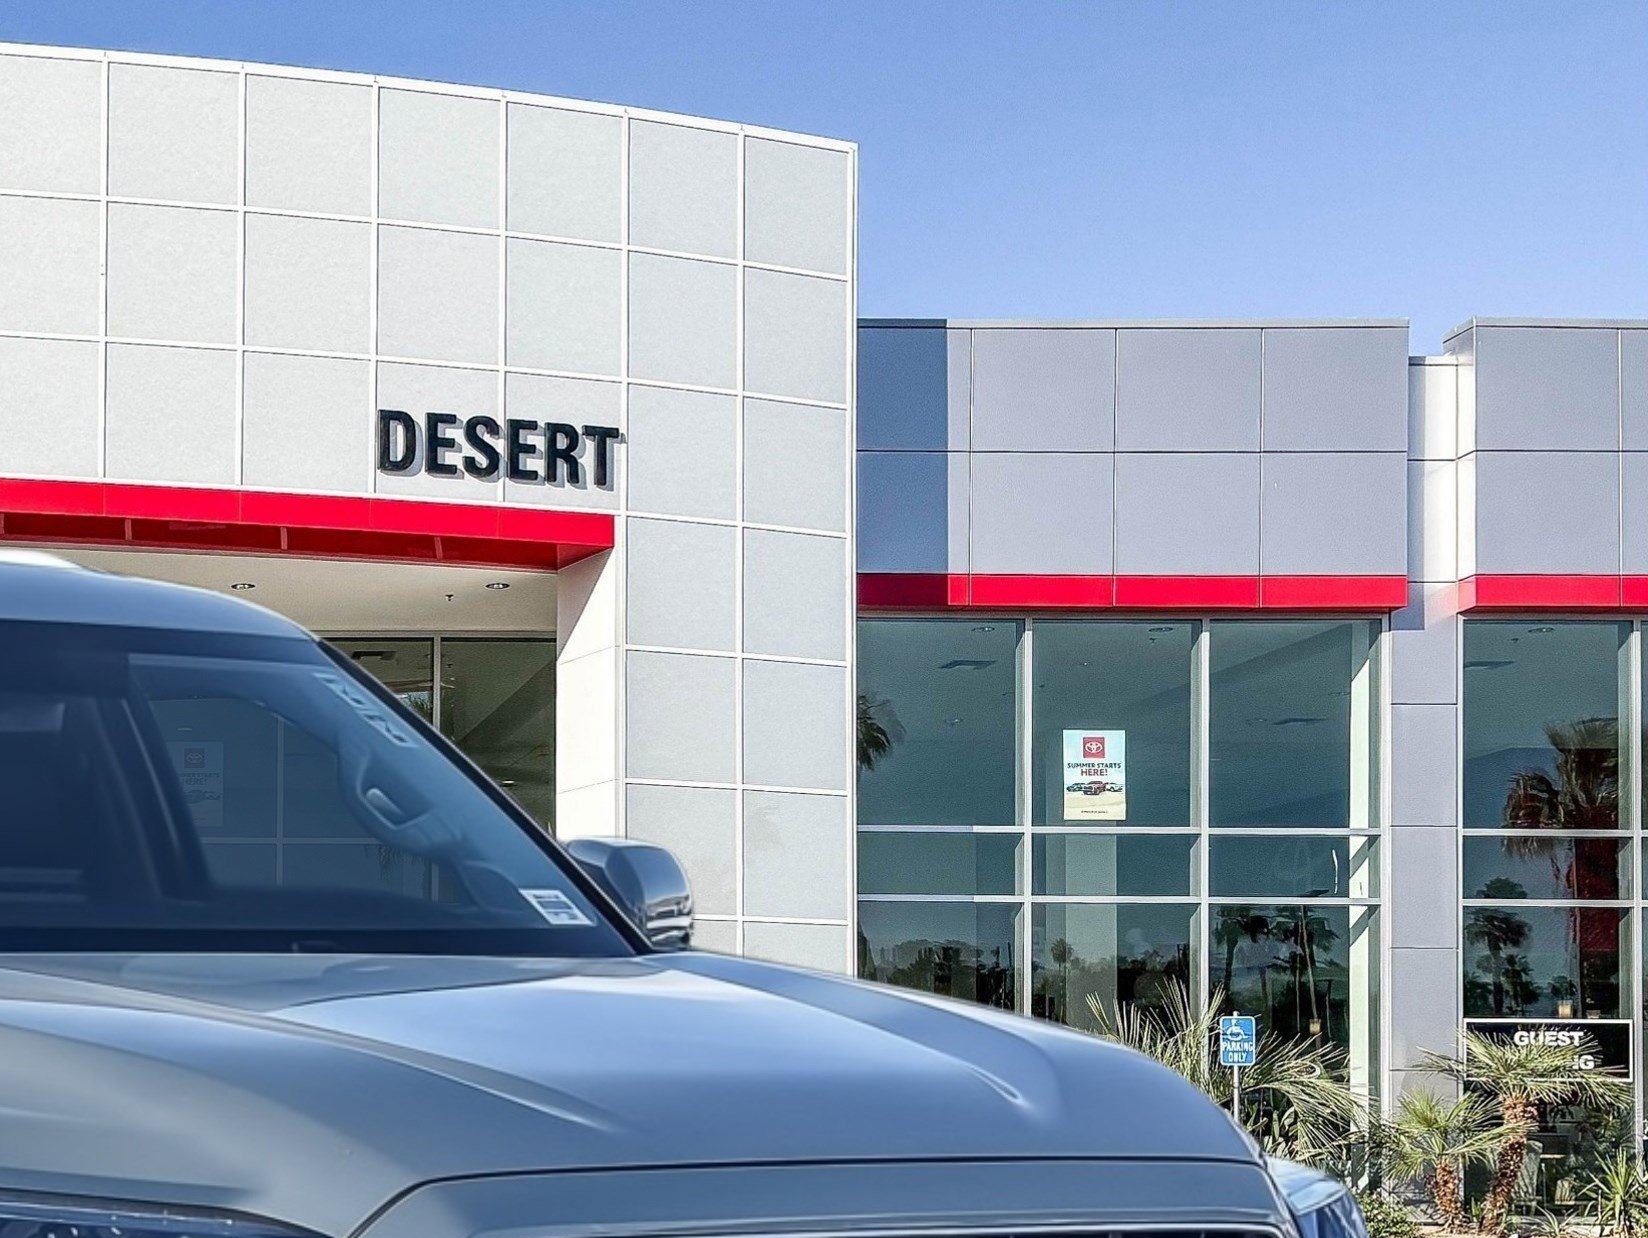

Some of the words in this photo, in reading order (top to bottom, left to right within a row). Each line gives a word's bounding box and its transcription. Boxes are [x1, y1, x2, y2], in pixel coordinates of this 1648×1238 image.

[377, 409, 620, 487] DESERT
[1513, 1030, 1585, 1047] GUEST
[1222, 1041, 1254, 1052] PARKING
[1228, 1052, 1247, 1062] ONLY
